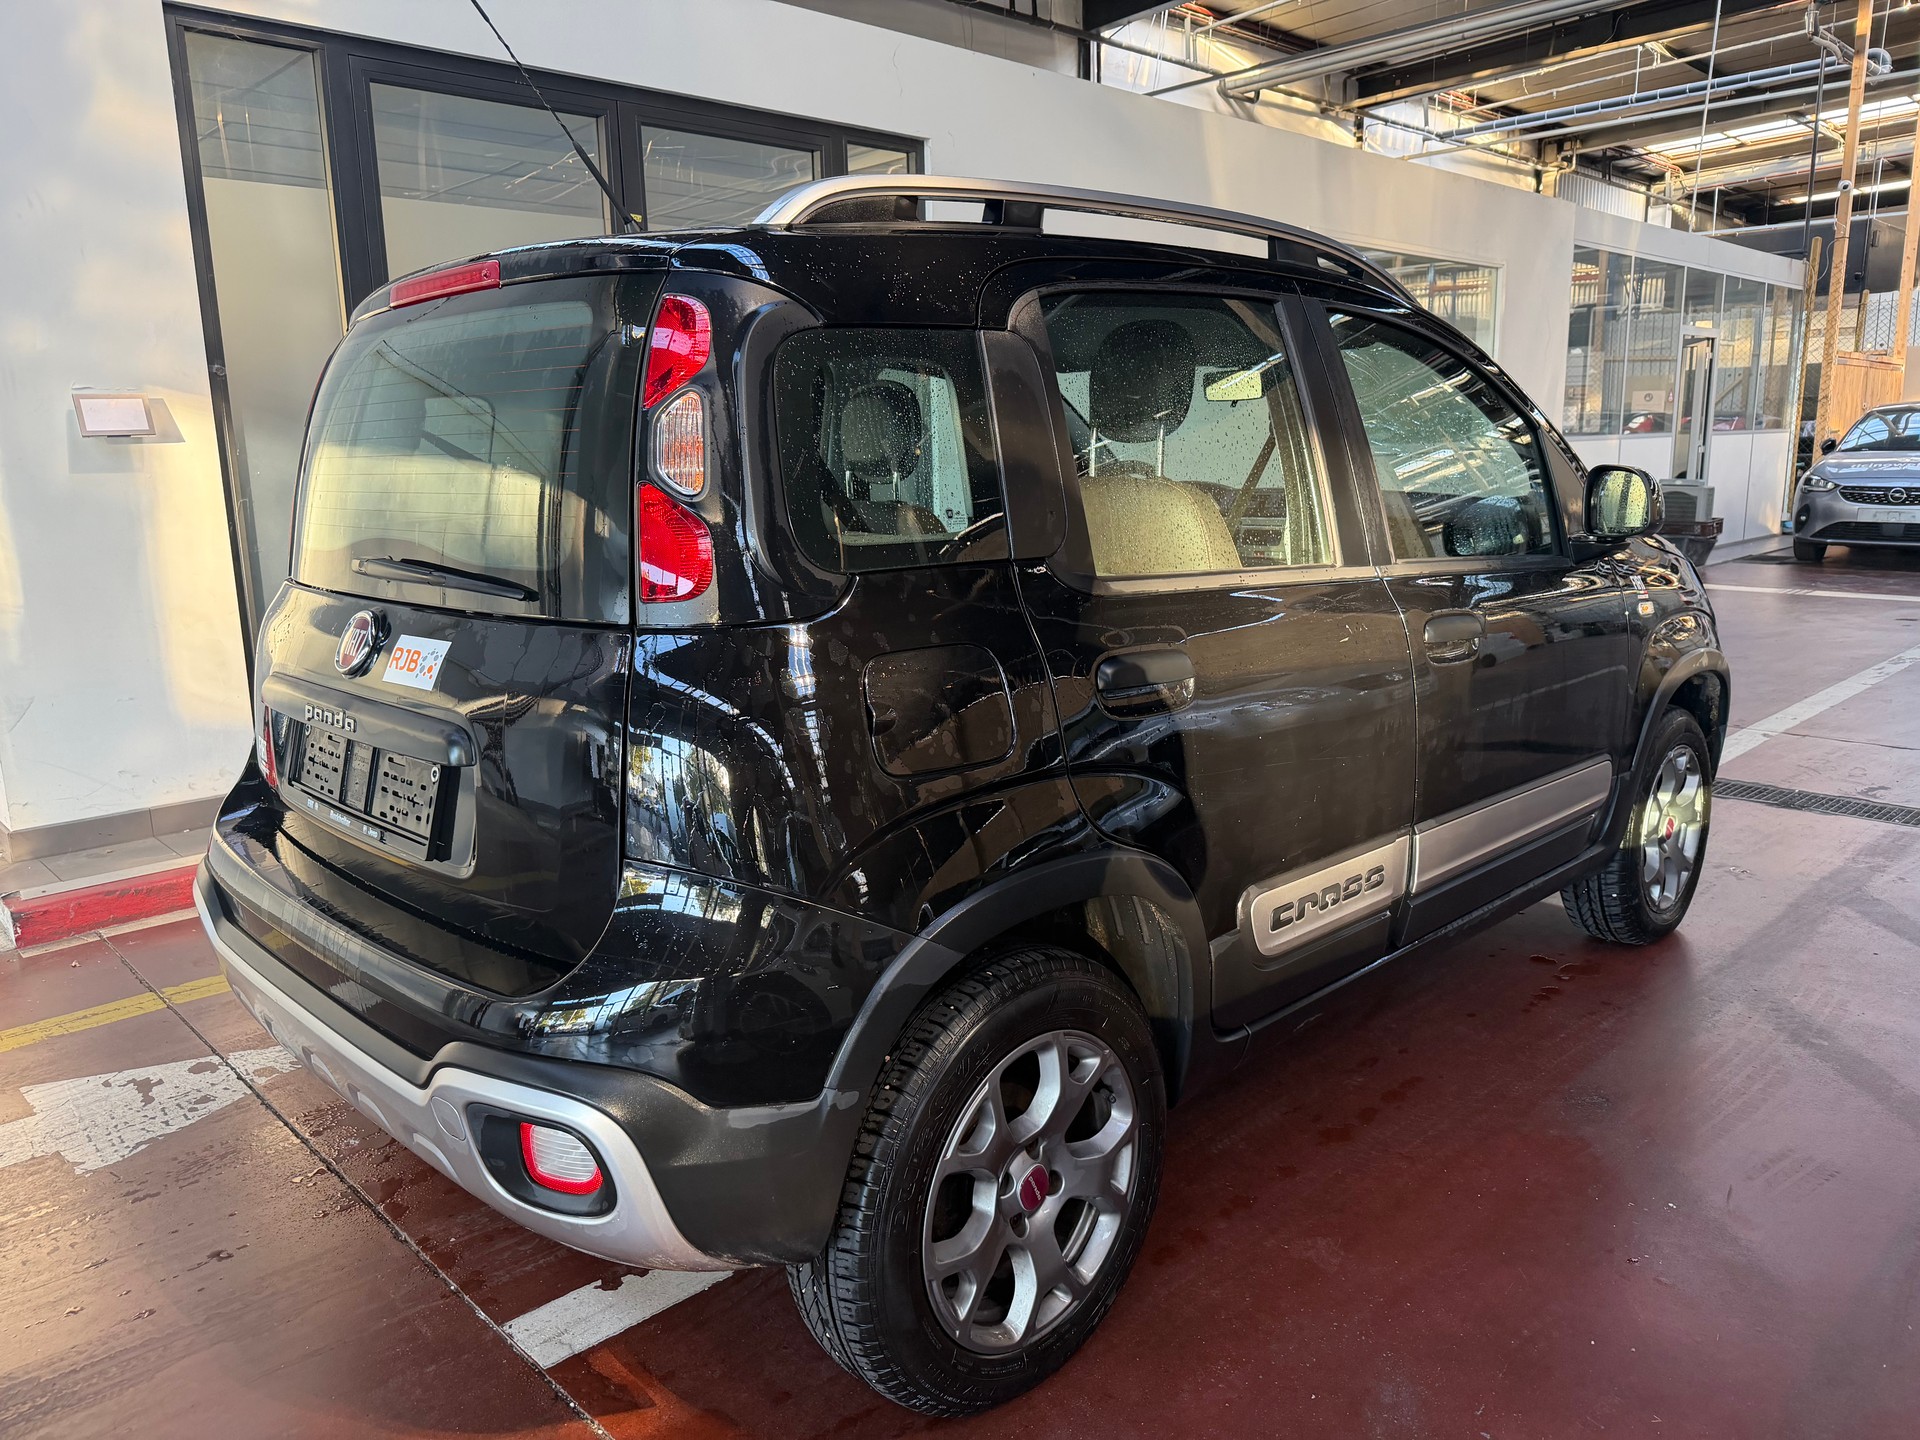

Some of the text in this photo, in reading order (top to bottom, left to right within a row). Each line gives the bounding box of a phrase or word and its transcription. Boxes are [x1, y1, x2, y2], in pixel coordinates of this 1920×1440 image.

[389, 647, 421, 673] RJB
[304, 703, 357, 733] panda
[1270, 864, 1385, 932] CROSS
